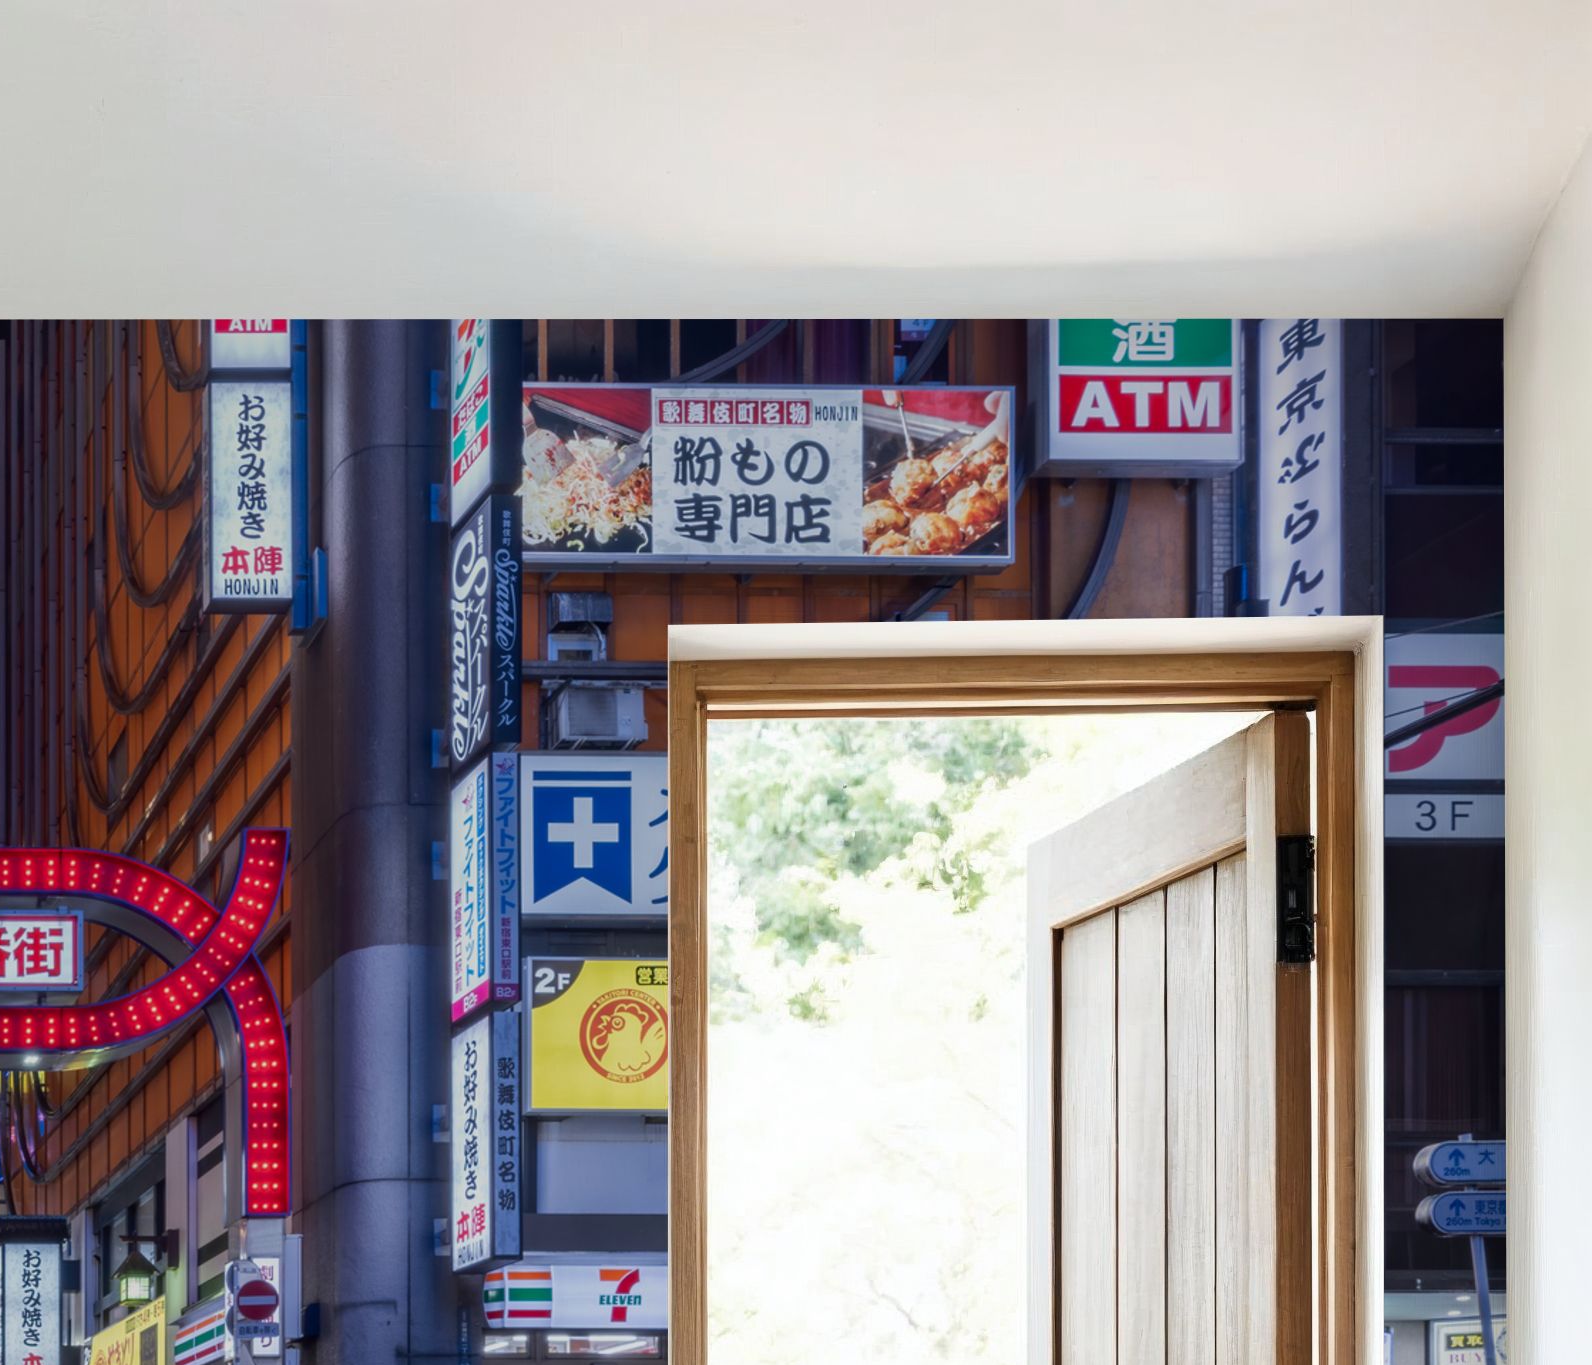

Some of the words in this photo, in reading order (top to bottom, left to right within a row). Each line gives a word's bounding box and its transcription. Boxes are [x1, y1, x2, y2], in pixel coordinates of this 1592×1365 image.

[1112, 319, 1177, 363] 酒
[662, 402, 808, 424] 歌舞伎町名物
[815, 406, 858, 422] HONJIN
[1071, 381, 1221, 428] ATM
[237, 394, 267, 539] お好み焼き
[673, 436, 831, 487] 粉もの
[673, 493, 832, 544] 専門店
[221, 546, 284, 576] 本陣
[224, 578, 279, 596] HONJIN
[495, 549, 520, 651] Sparkle
[452, 529, 490, 761] Sparkle
[534, 967, 571, 994] 2F
[463, 1040, 479, 1200] お好み焼き
[497, 1057, 516, 1212] 歌舞伎町名物
[456, 1203, 486, 1243] 本陣
[22, 1249, 42, 1348] お好み焼き
